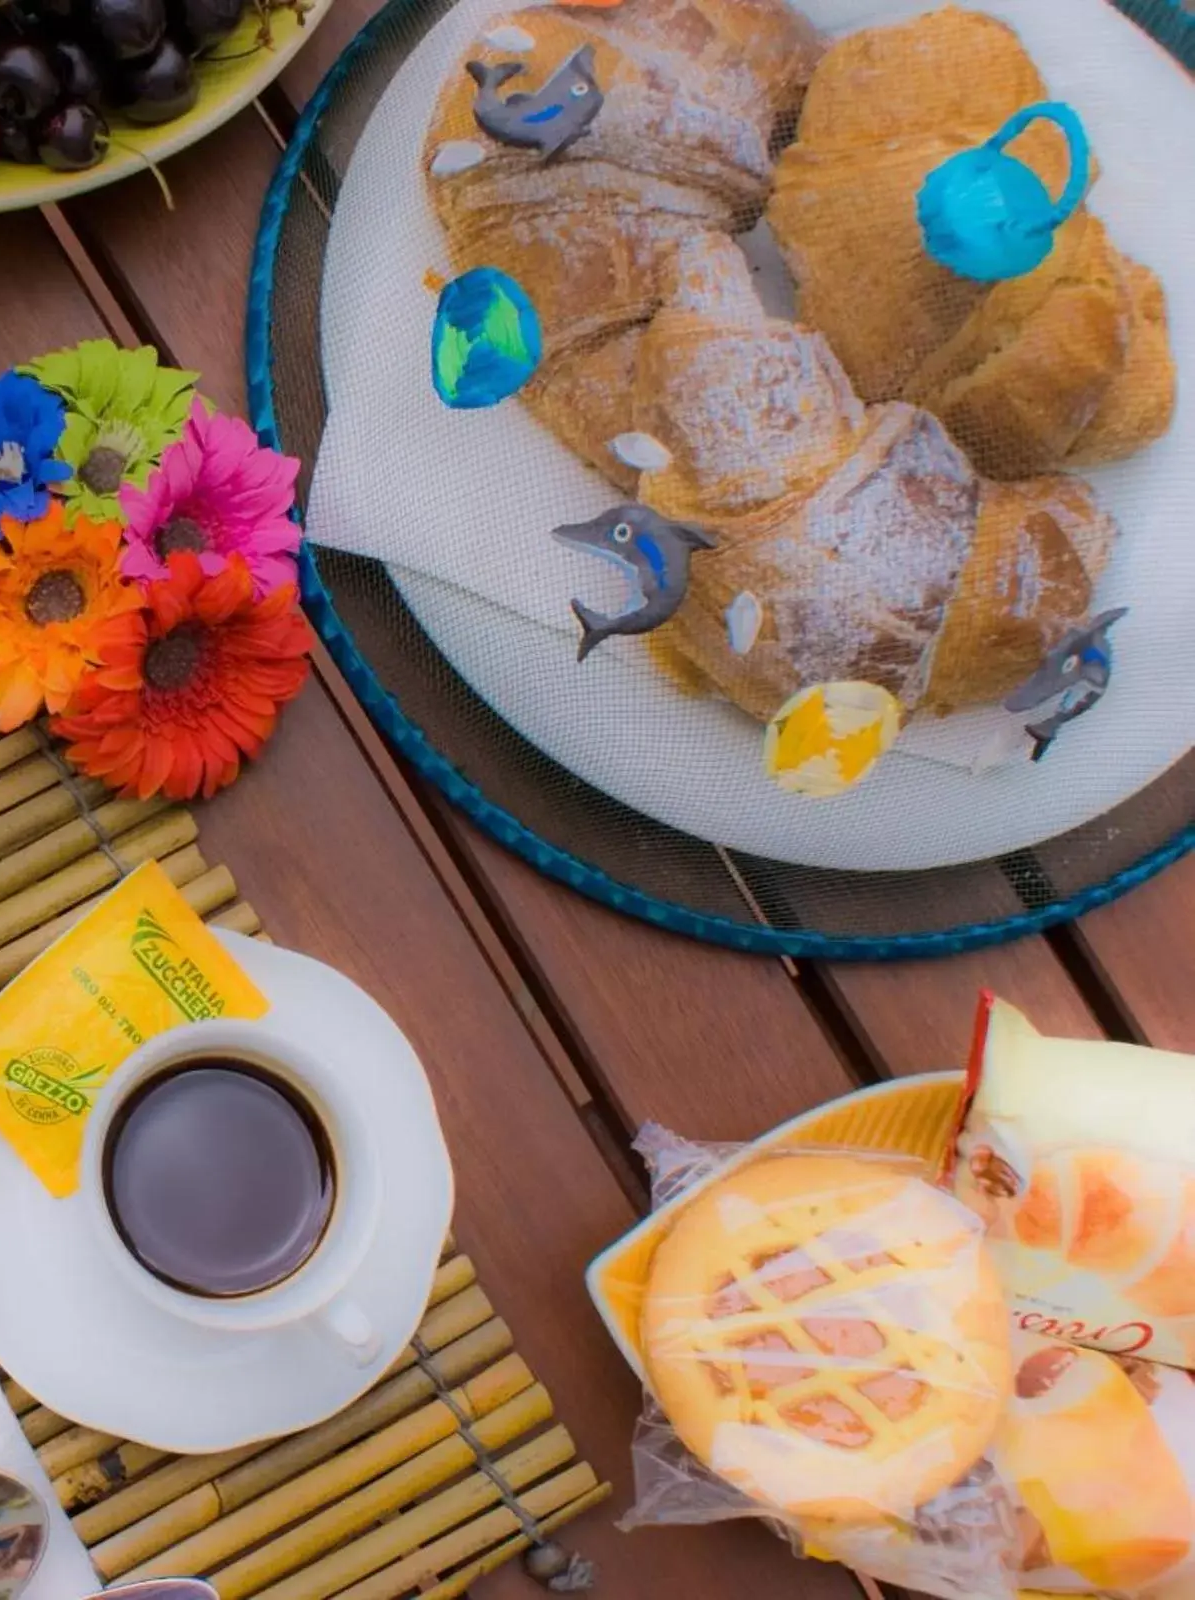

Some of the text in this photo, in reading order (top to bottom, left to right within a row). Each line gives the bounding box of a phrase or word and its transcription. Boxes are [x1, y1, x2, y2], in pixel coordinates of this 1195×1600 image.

[139, 941, 214, 1021] ZUCCHER
[179, 957, 225, 1018] ITALIA
[117, 1016, 146, 1045] TRO
[8, 1062, 84, 1112] GREZZO
